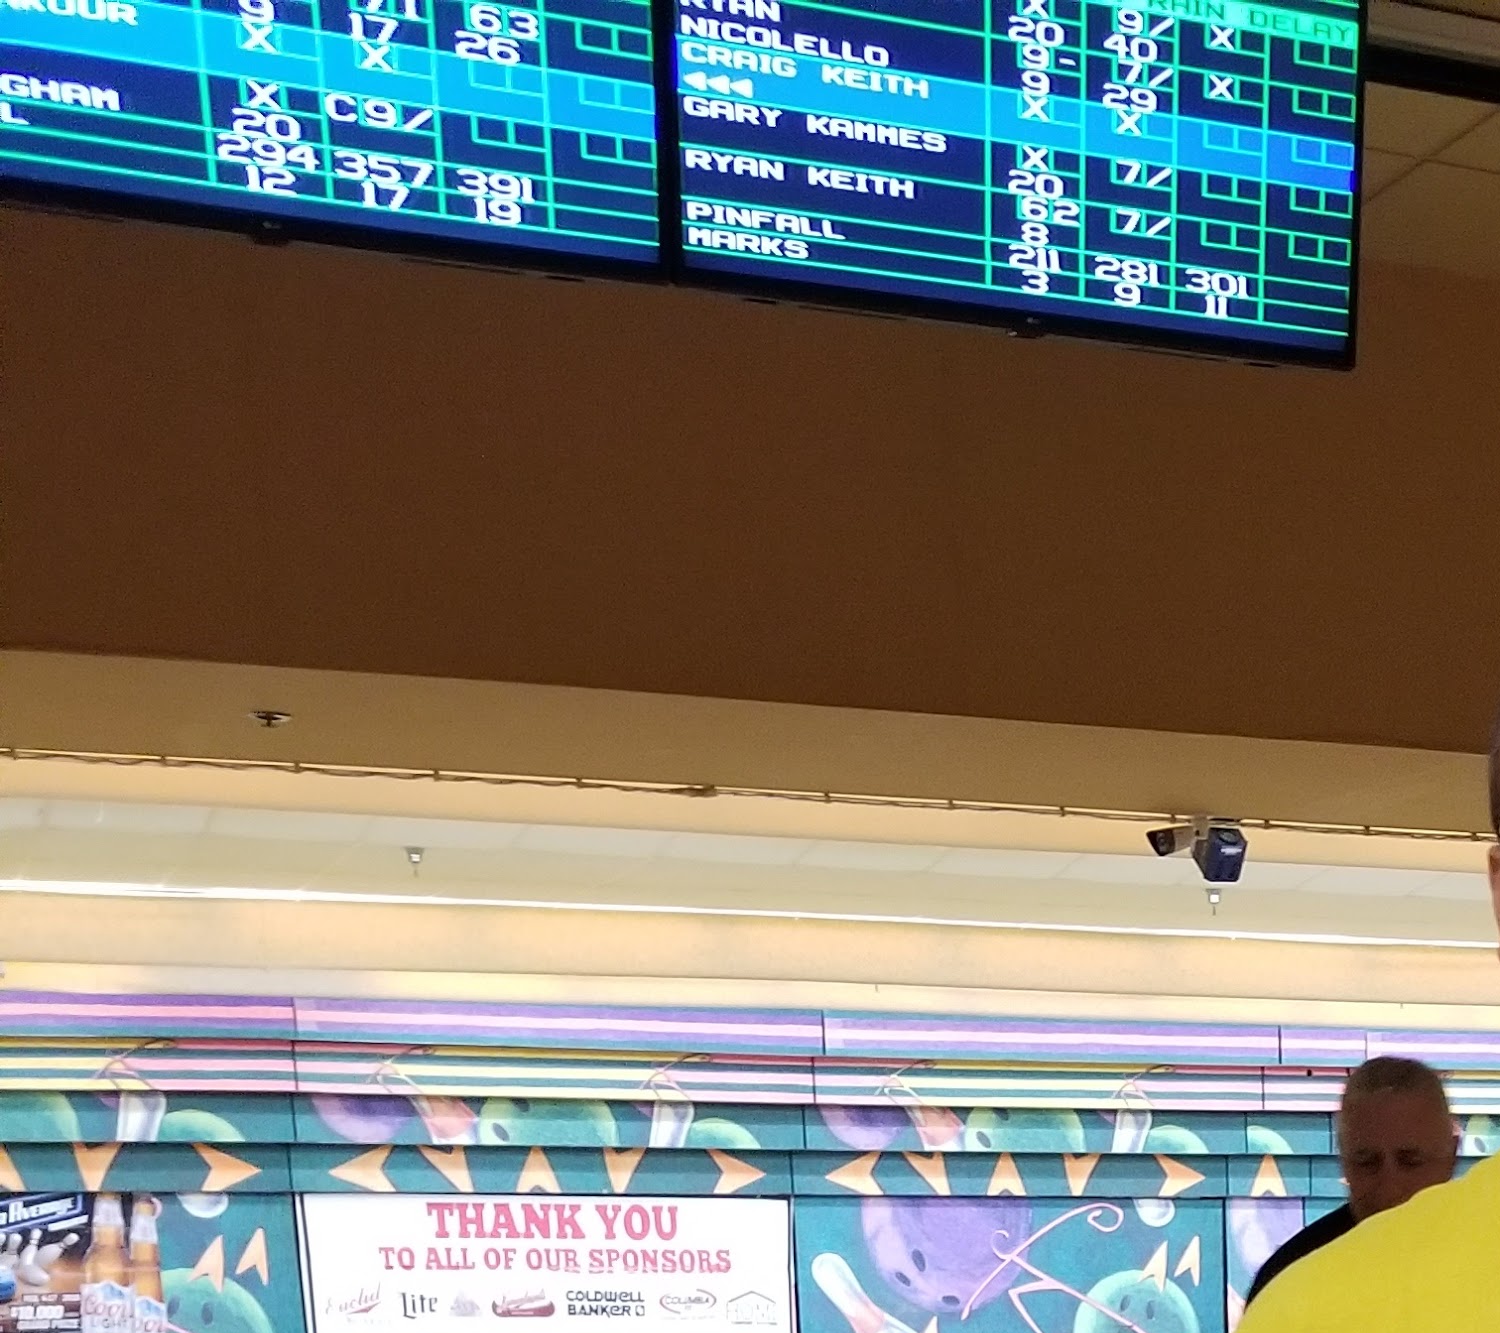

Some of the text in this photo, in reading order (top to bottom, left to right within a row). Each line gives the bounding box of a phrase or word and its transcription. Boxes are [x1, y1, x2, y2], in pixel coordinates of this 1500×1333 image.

[349, 12, 399, 45] 17
[455, 30, 520, 66] 26
[470, 4, 540, 39] 63
[680, 14, 1158, 68] NICOLELLO 20 40
[681, 41, 930, 99] CRAIG KEITH
[1021, 70, 1157, 114] 9 29
[231, 107, 301, 142] 20
[683, 95, 948, 153] GARY KAMMES
[217, 132, 319, 172] 294
[334, 150, 434, 187] 357
[456, 167, 536, 203] 391
[684, 149, 915, 199] RYAN KEITH
[1008, 169, 1063, 200] 20
[245, 164, 522, 227] 12 17 19
[1021, 196, 1080, 226] 62
[686, 201, 1249, 300] PINFALL 211 281 301
[1021, 222, 1049, 248] 8
[687, 227, 1229, 320] MARKS 3 9 11
[426, 1202, 679, 1241] THANK YOU
[379, 1247, 732, 1274] TO ALL OF OUR SPONSORS
[400, 1292, 439, 1320] Lite
